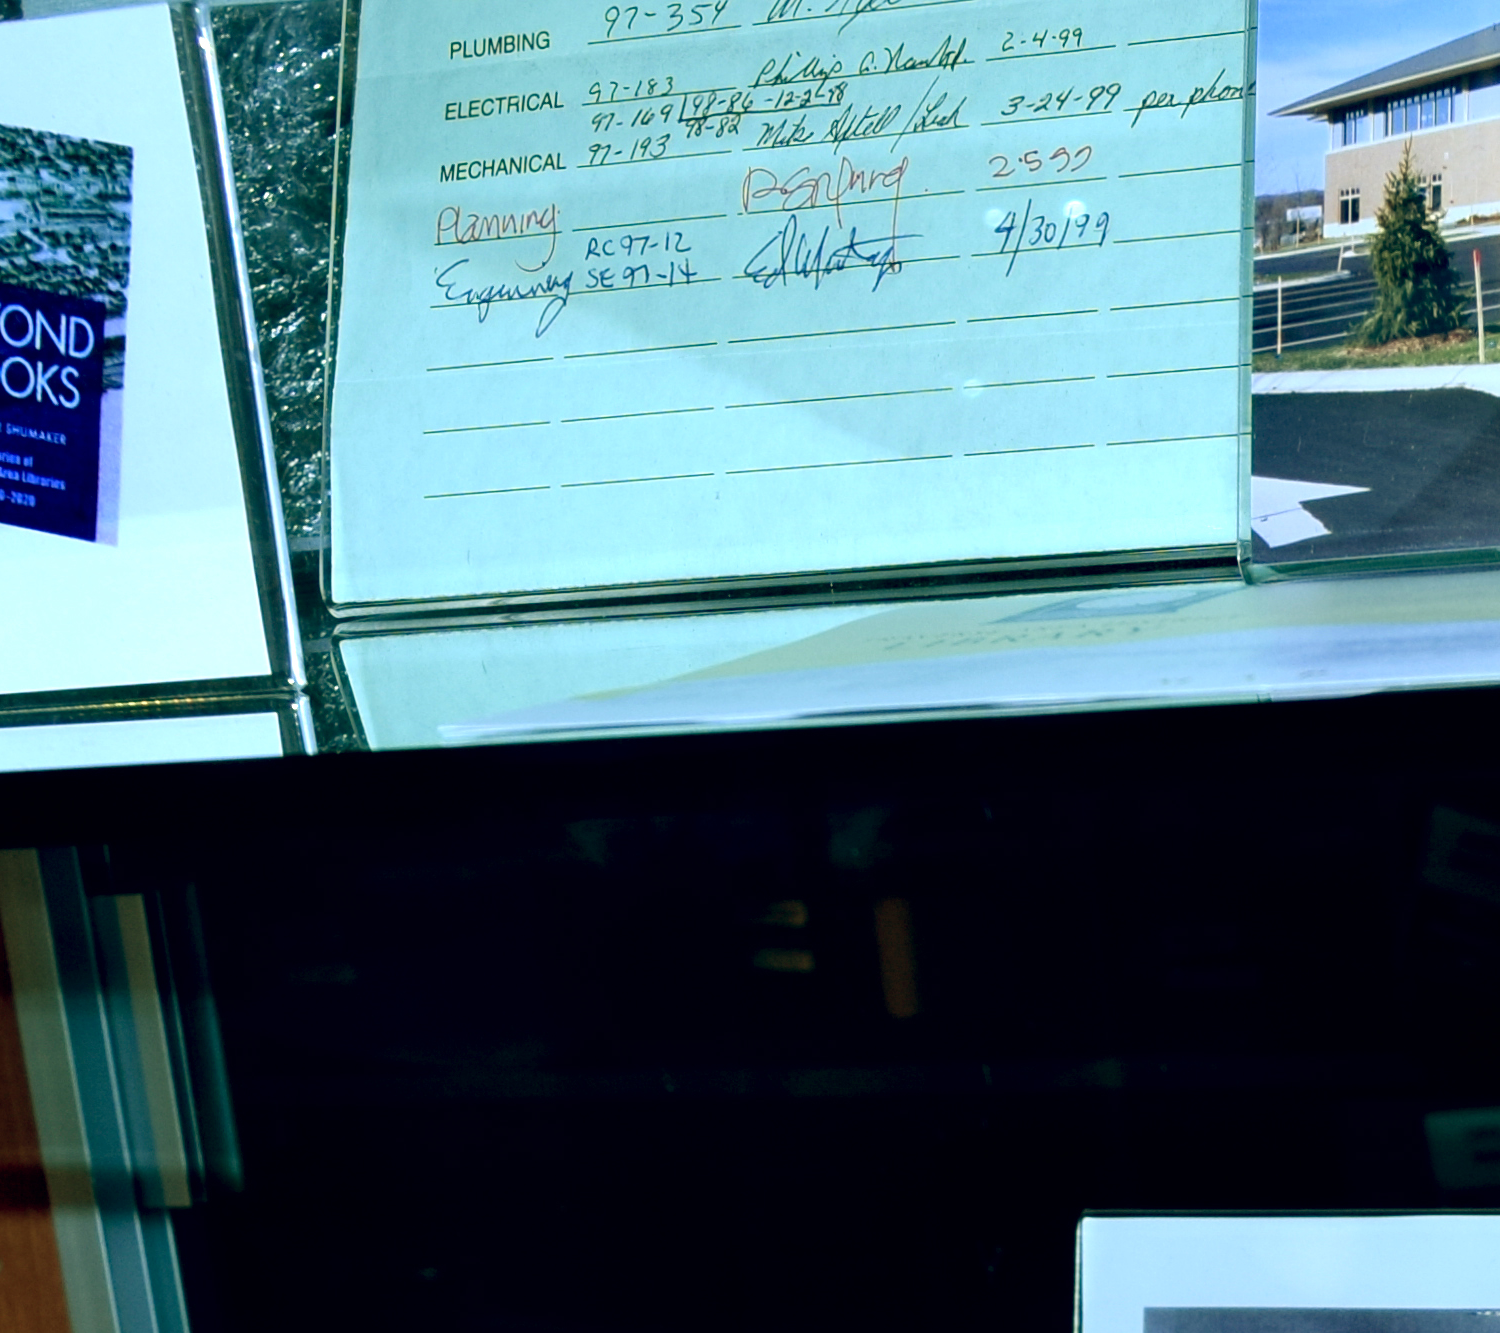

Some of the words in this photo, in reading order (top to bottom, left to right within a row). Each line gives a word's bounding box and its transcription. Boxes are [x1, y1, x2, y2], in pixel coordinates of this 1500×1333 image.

[449, 31, 551, 60] PLUMBING
[588, 77, 675, 104] 97-183
[1000, 82, 1122, 116] 3-24-99
[444, 92, 565, 121] ELECTRICAL
[1130, 91, 1178, 128] per
[587, 134, 671, 167] 97-193
[440, 152, 567, 183] MECHANICAL
[436, 204, 561, 273] Planning
[621, 231, 692, 256] 97-12
[994, 199, 1111, 277] 4/30/99
[6, 422, 67, 445] SHUMAKER
[21, 470, 66, 490] Libraries
